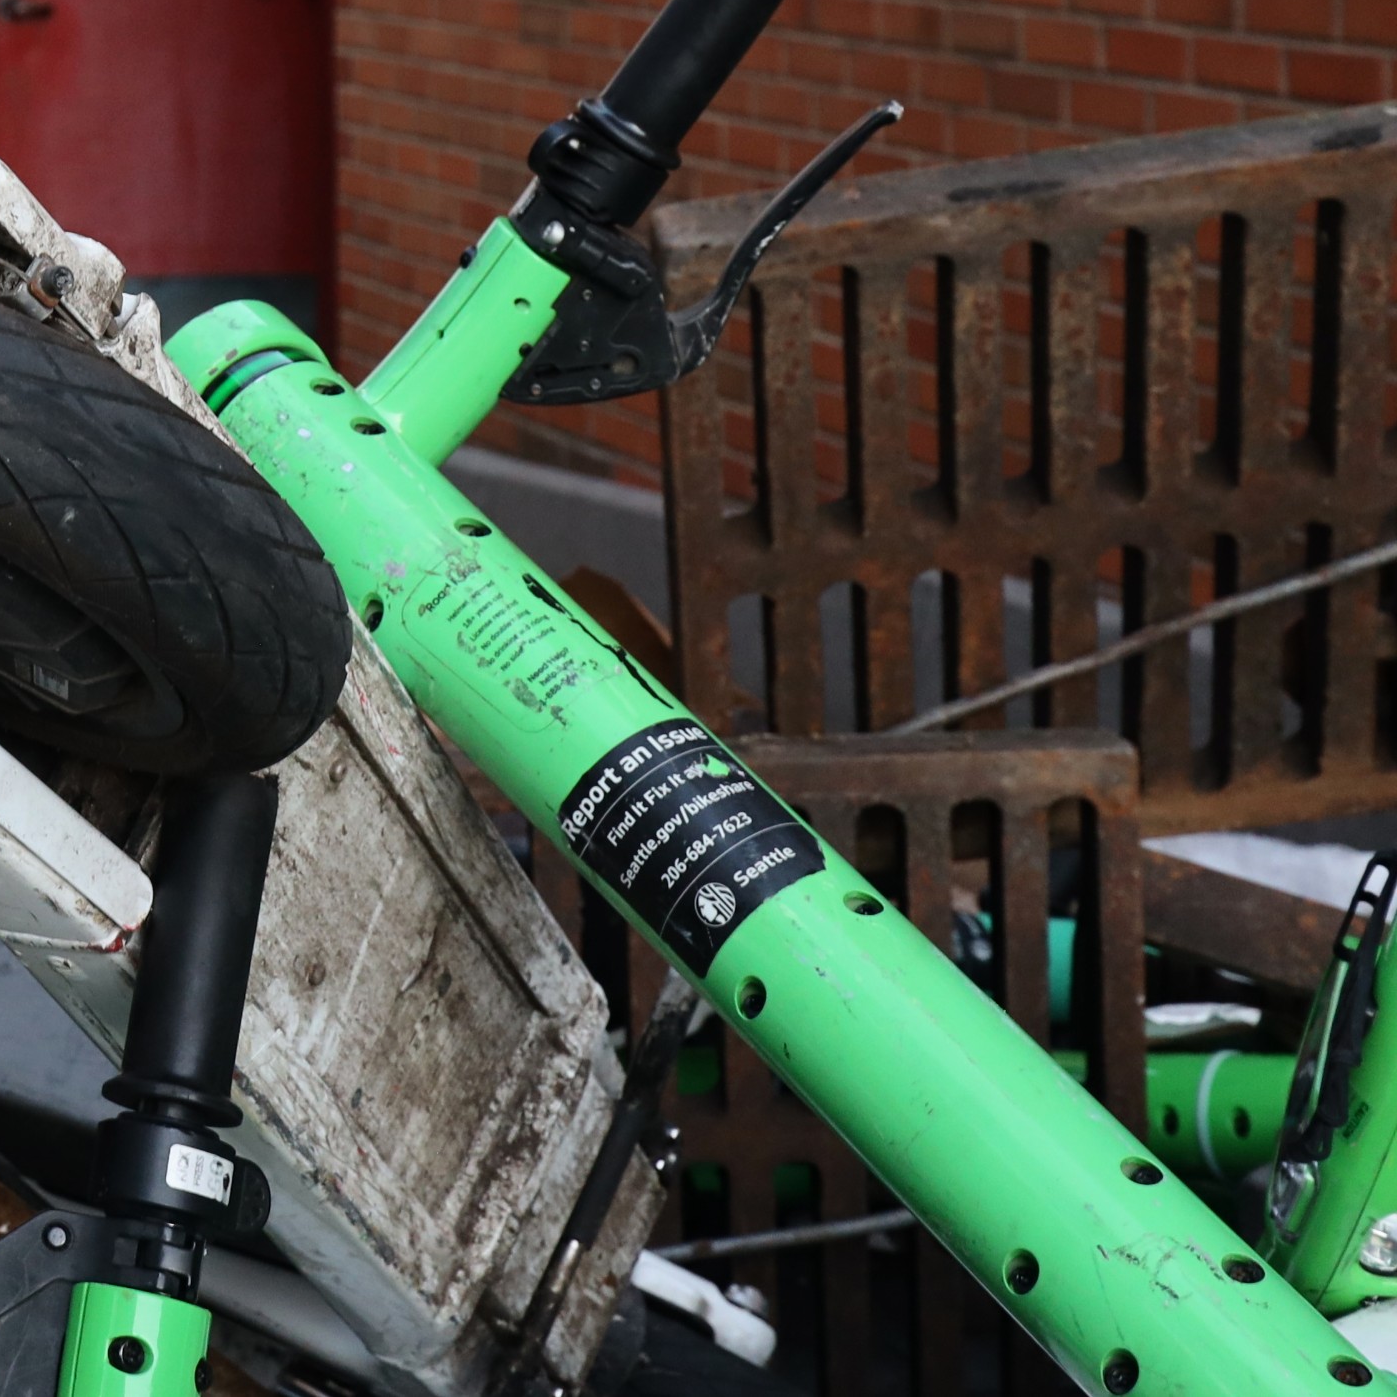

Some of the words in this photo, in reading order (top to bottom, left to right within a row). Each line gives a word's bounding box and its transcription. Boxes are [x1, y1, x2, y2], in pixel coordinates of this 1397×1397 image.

[560, 766, 623, 843] Report
[619, 745, 653, 774] an
[646, 726, 709, 753] Issue
[606, 809, 637, 848] Find
[631, 800, 649, 818] It
[643, 782, 672, 806] Fix
[666, 770, 686, 789] It
[619, 779, 755, 890] Seattle.gov/bikeshare
[660, 811, 753, 890] 206-684-7623
[733, 845, 797, 888] Seattle
